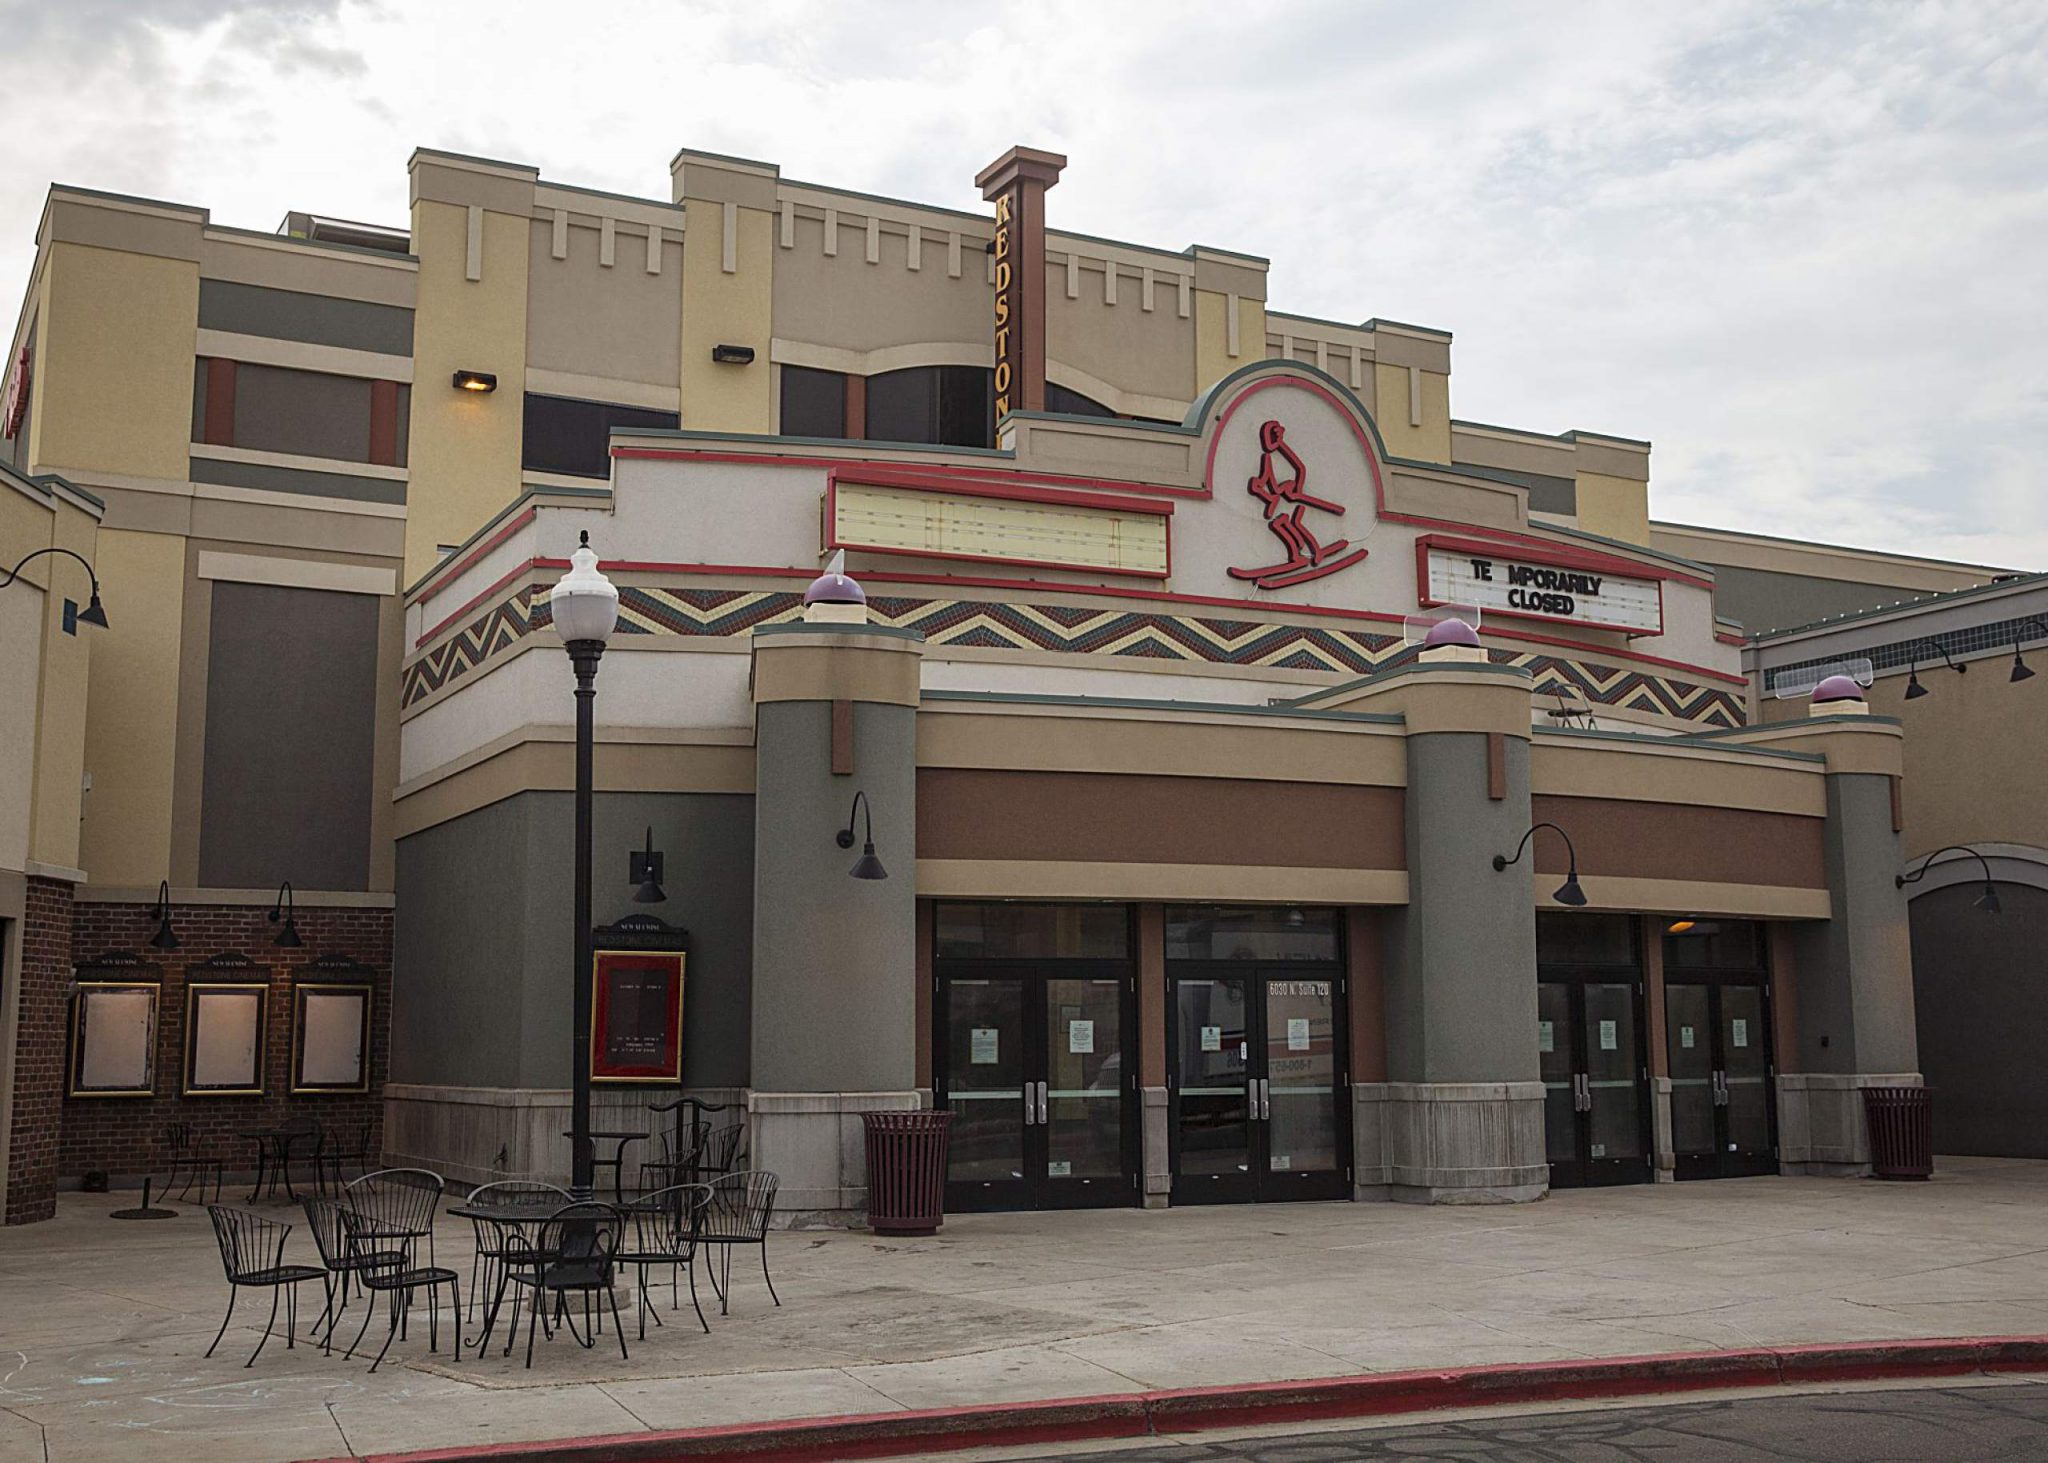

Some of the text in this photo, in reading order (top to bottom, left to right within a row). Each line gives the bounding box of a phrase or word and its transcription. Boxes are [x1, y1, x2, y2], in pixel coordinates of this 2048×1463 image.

[994, 193, 1011, 449] REDSTON
[1471, 559, 1602, 596] TE MPORARILY
[1508, 588, 1575, 615] CLOSED
[1270, 983, 1329, 996] 6030 N. Suite 120
